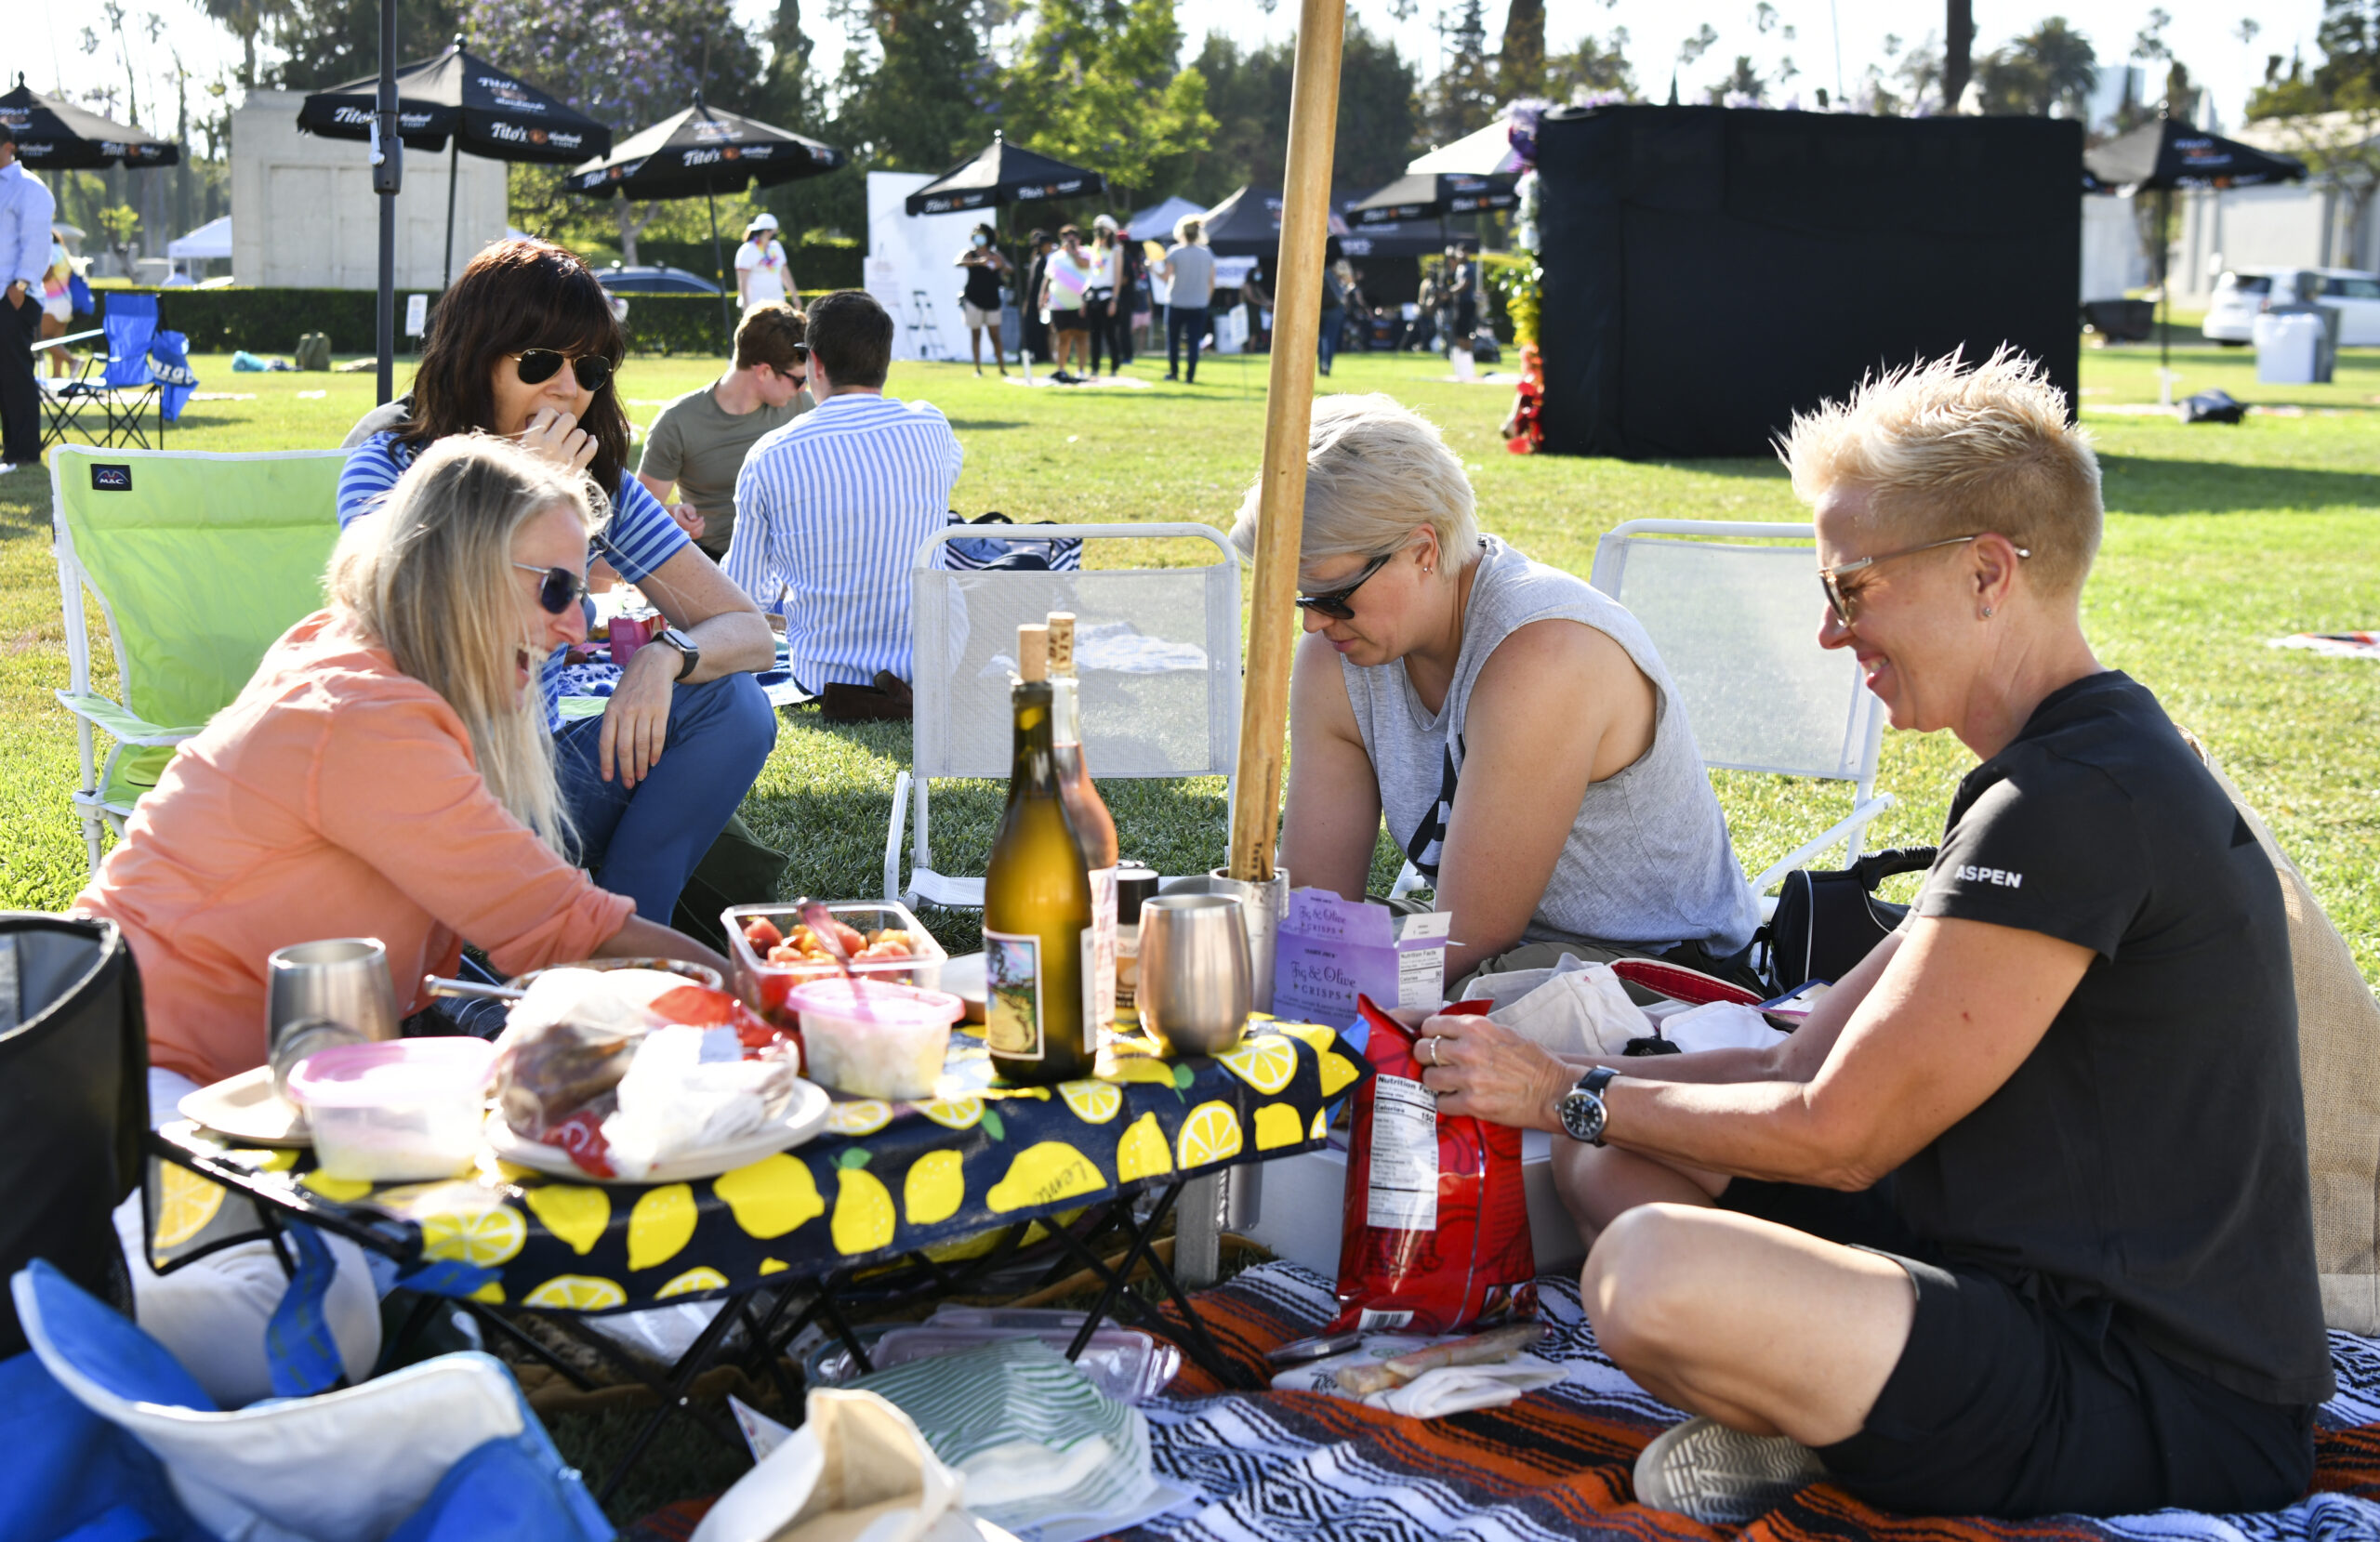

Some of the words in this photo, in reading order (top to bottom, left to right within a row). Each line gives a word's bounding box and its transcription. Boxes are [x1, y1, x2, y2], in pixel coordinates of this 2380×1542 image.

[491, 122, 528, 143] Tito's
[682, 148, 721, 167] Tito's
[1954, 864, 2022, 889] ASPEN
[1308, 965, 1322, 982] &
[1324, 966, 1355, 987] Olive
[1302, 983, 1341, 1001] CRISPS
[1378, 1075, 1416, 1090] Nutrition
[1374, 1103, 1405, 1114] Calories
[1421, 1112, 1435, 1124] 150
